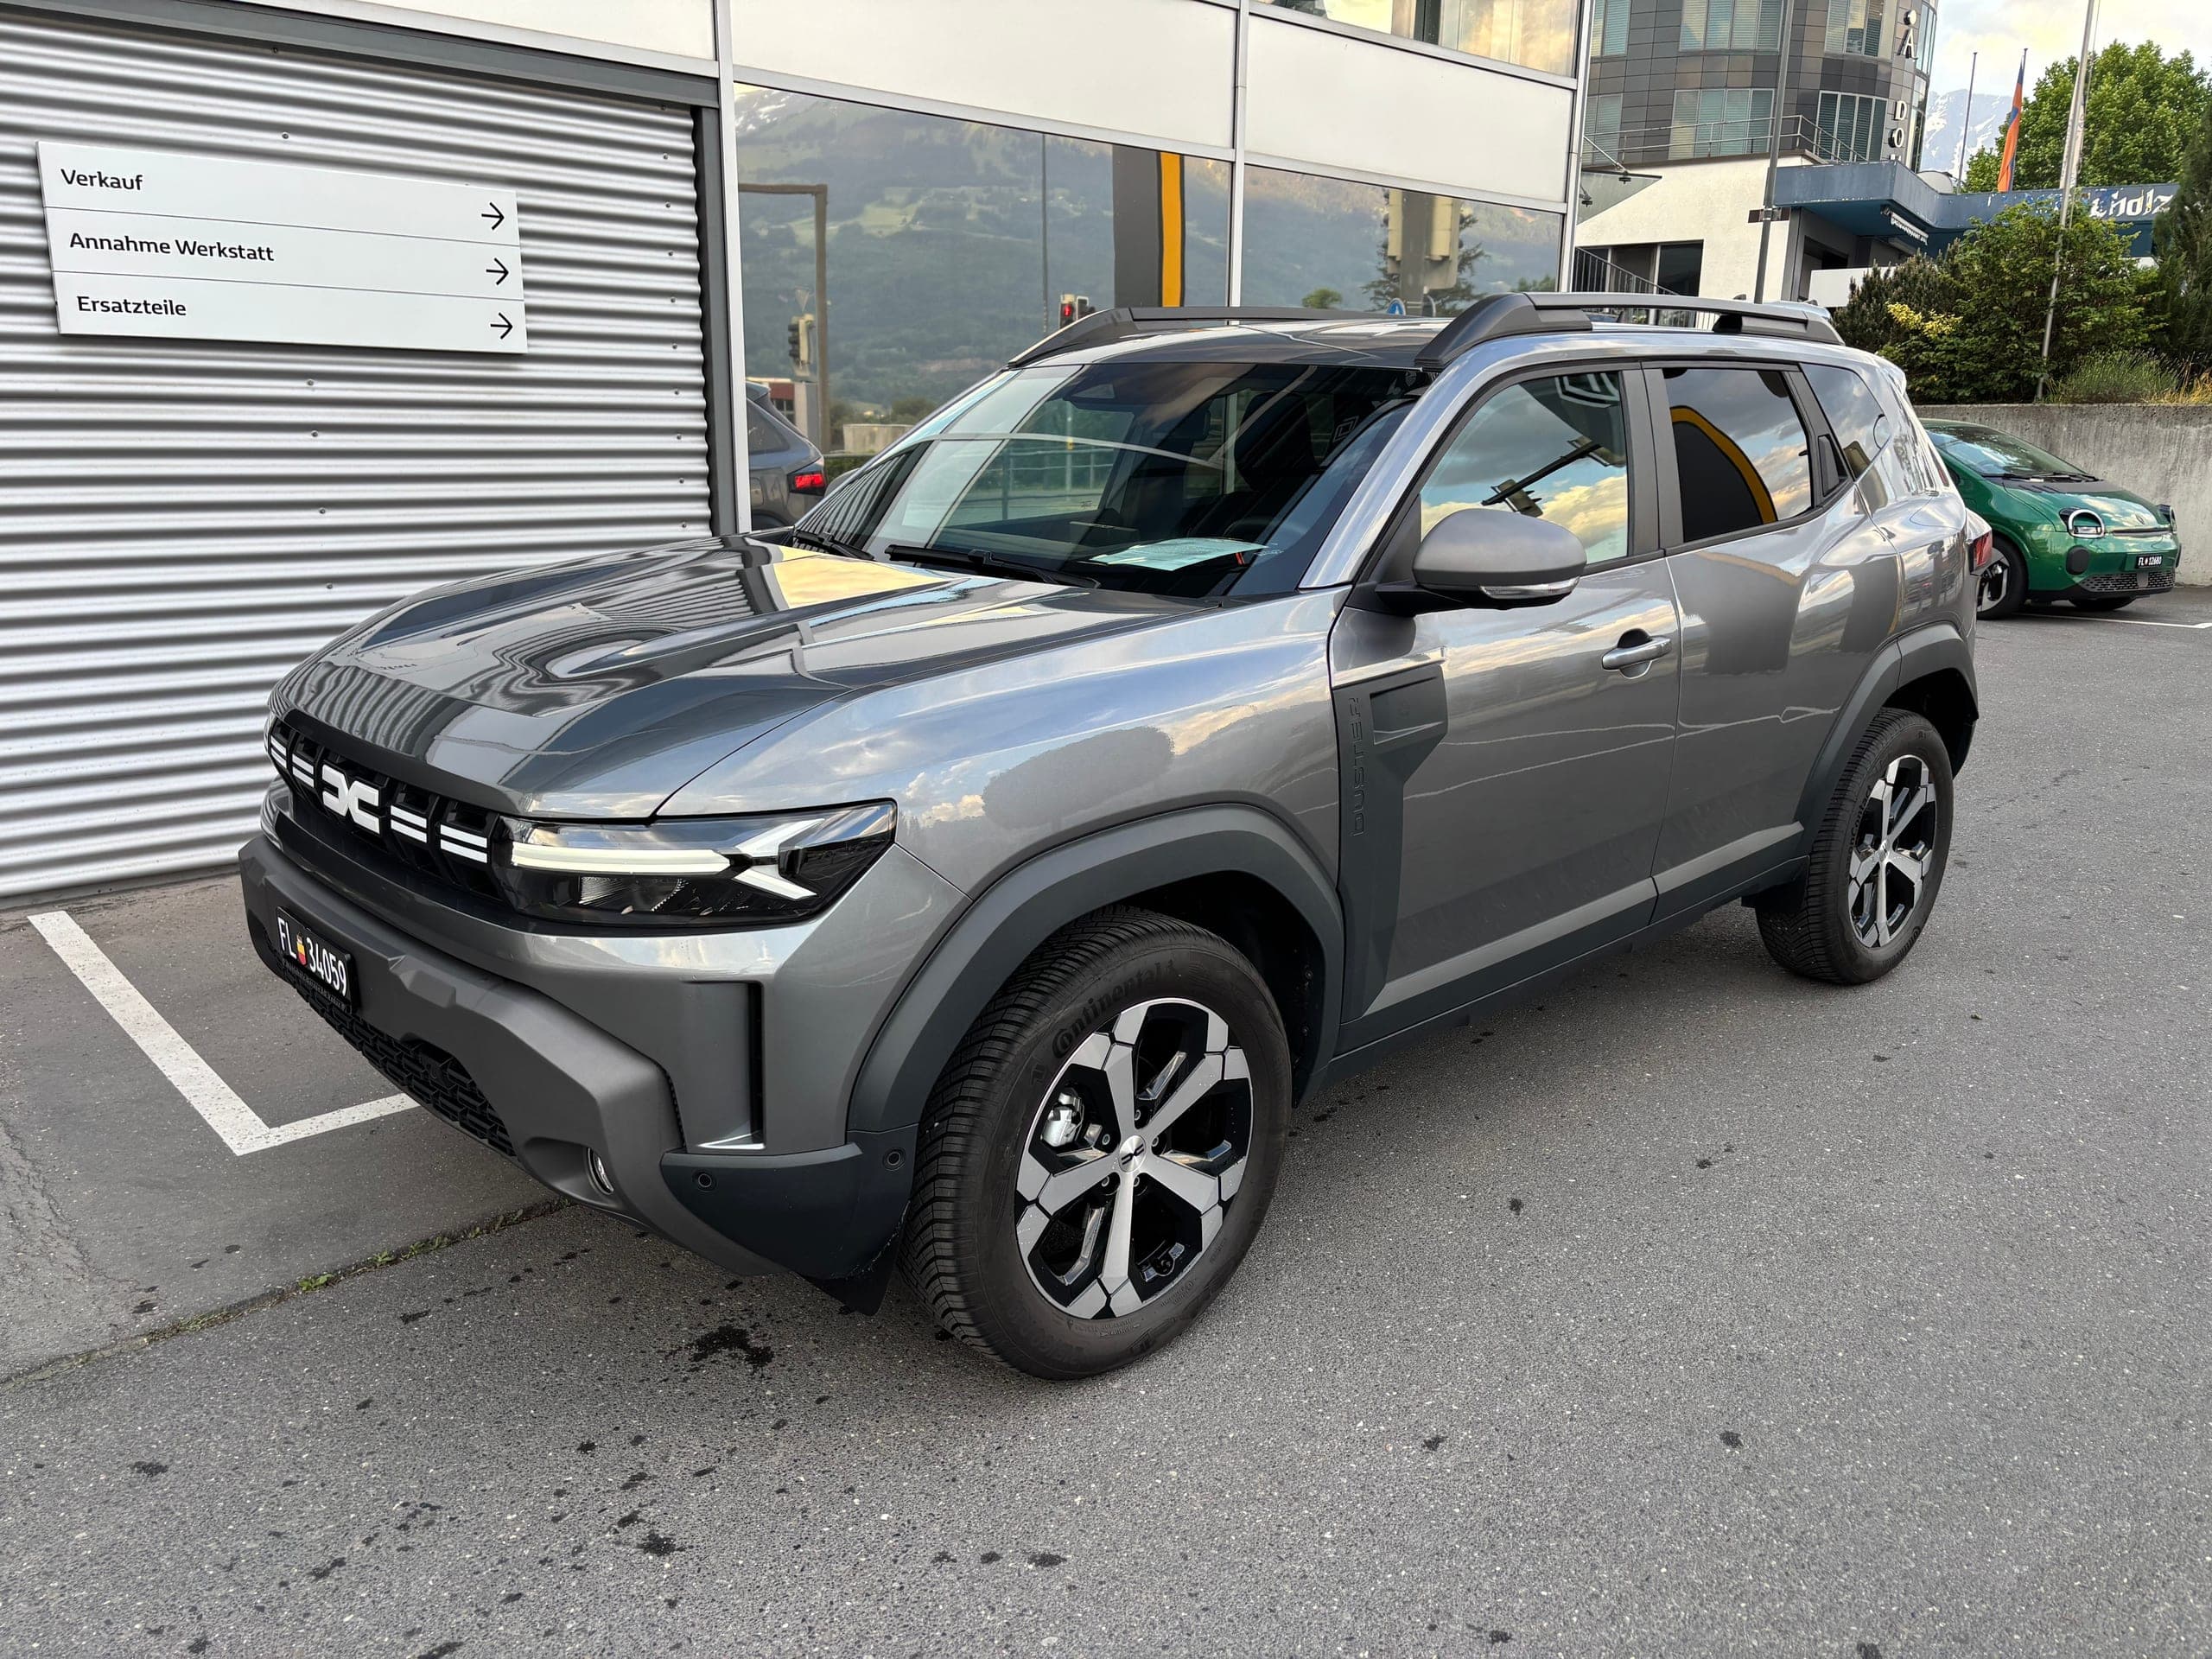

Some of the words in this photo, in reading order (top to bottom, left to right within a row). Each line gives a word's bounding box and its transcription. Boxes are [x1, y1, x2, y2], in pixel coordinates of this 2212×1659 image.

[60, 168, 143, 191] Verkauf
[70, 232, 171, 254] Annahme
[175, 239, 274, 262] Werkstatt
[77, 296, 187, 316] Ersatzteile
[1347, 697, 1365, 837] DUSTER
[276, 916, 298, 960] FL
[306, 937, 347, 996] 34059
[1052, 961, 1162, 1058] Continental
